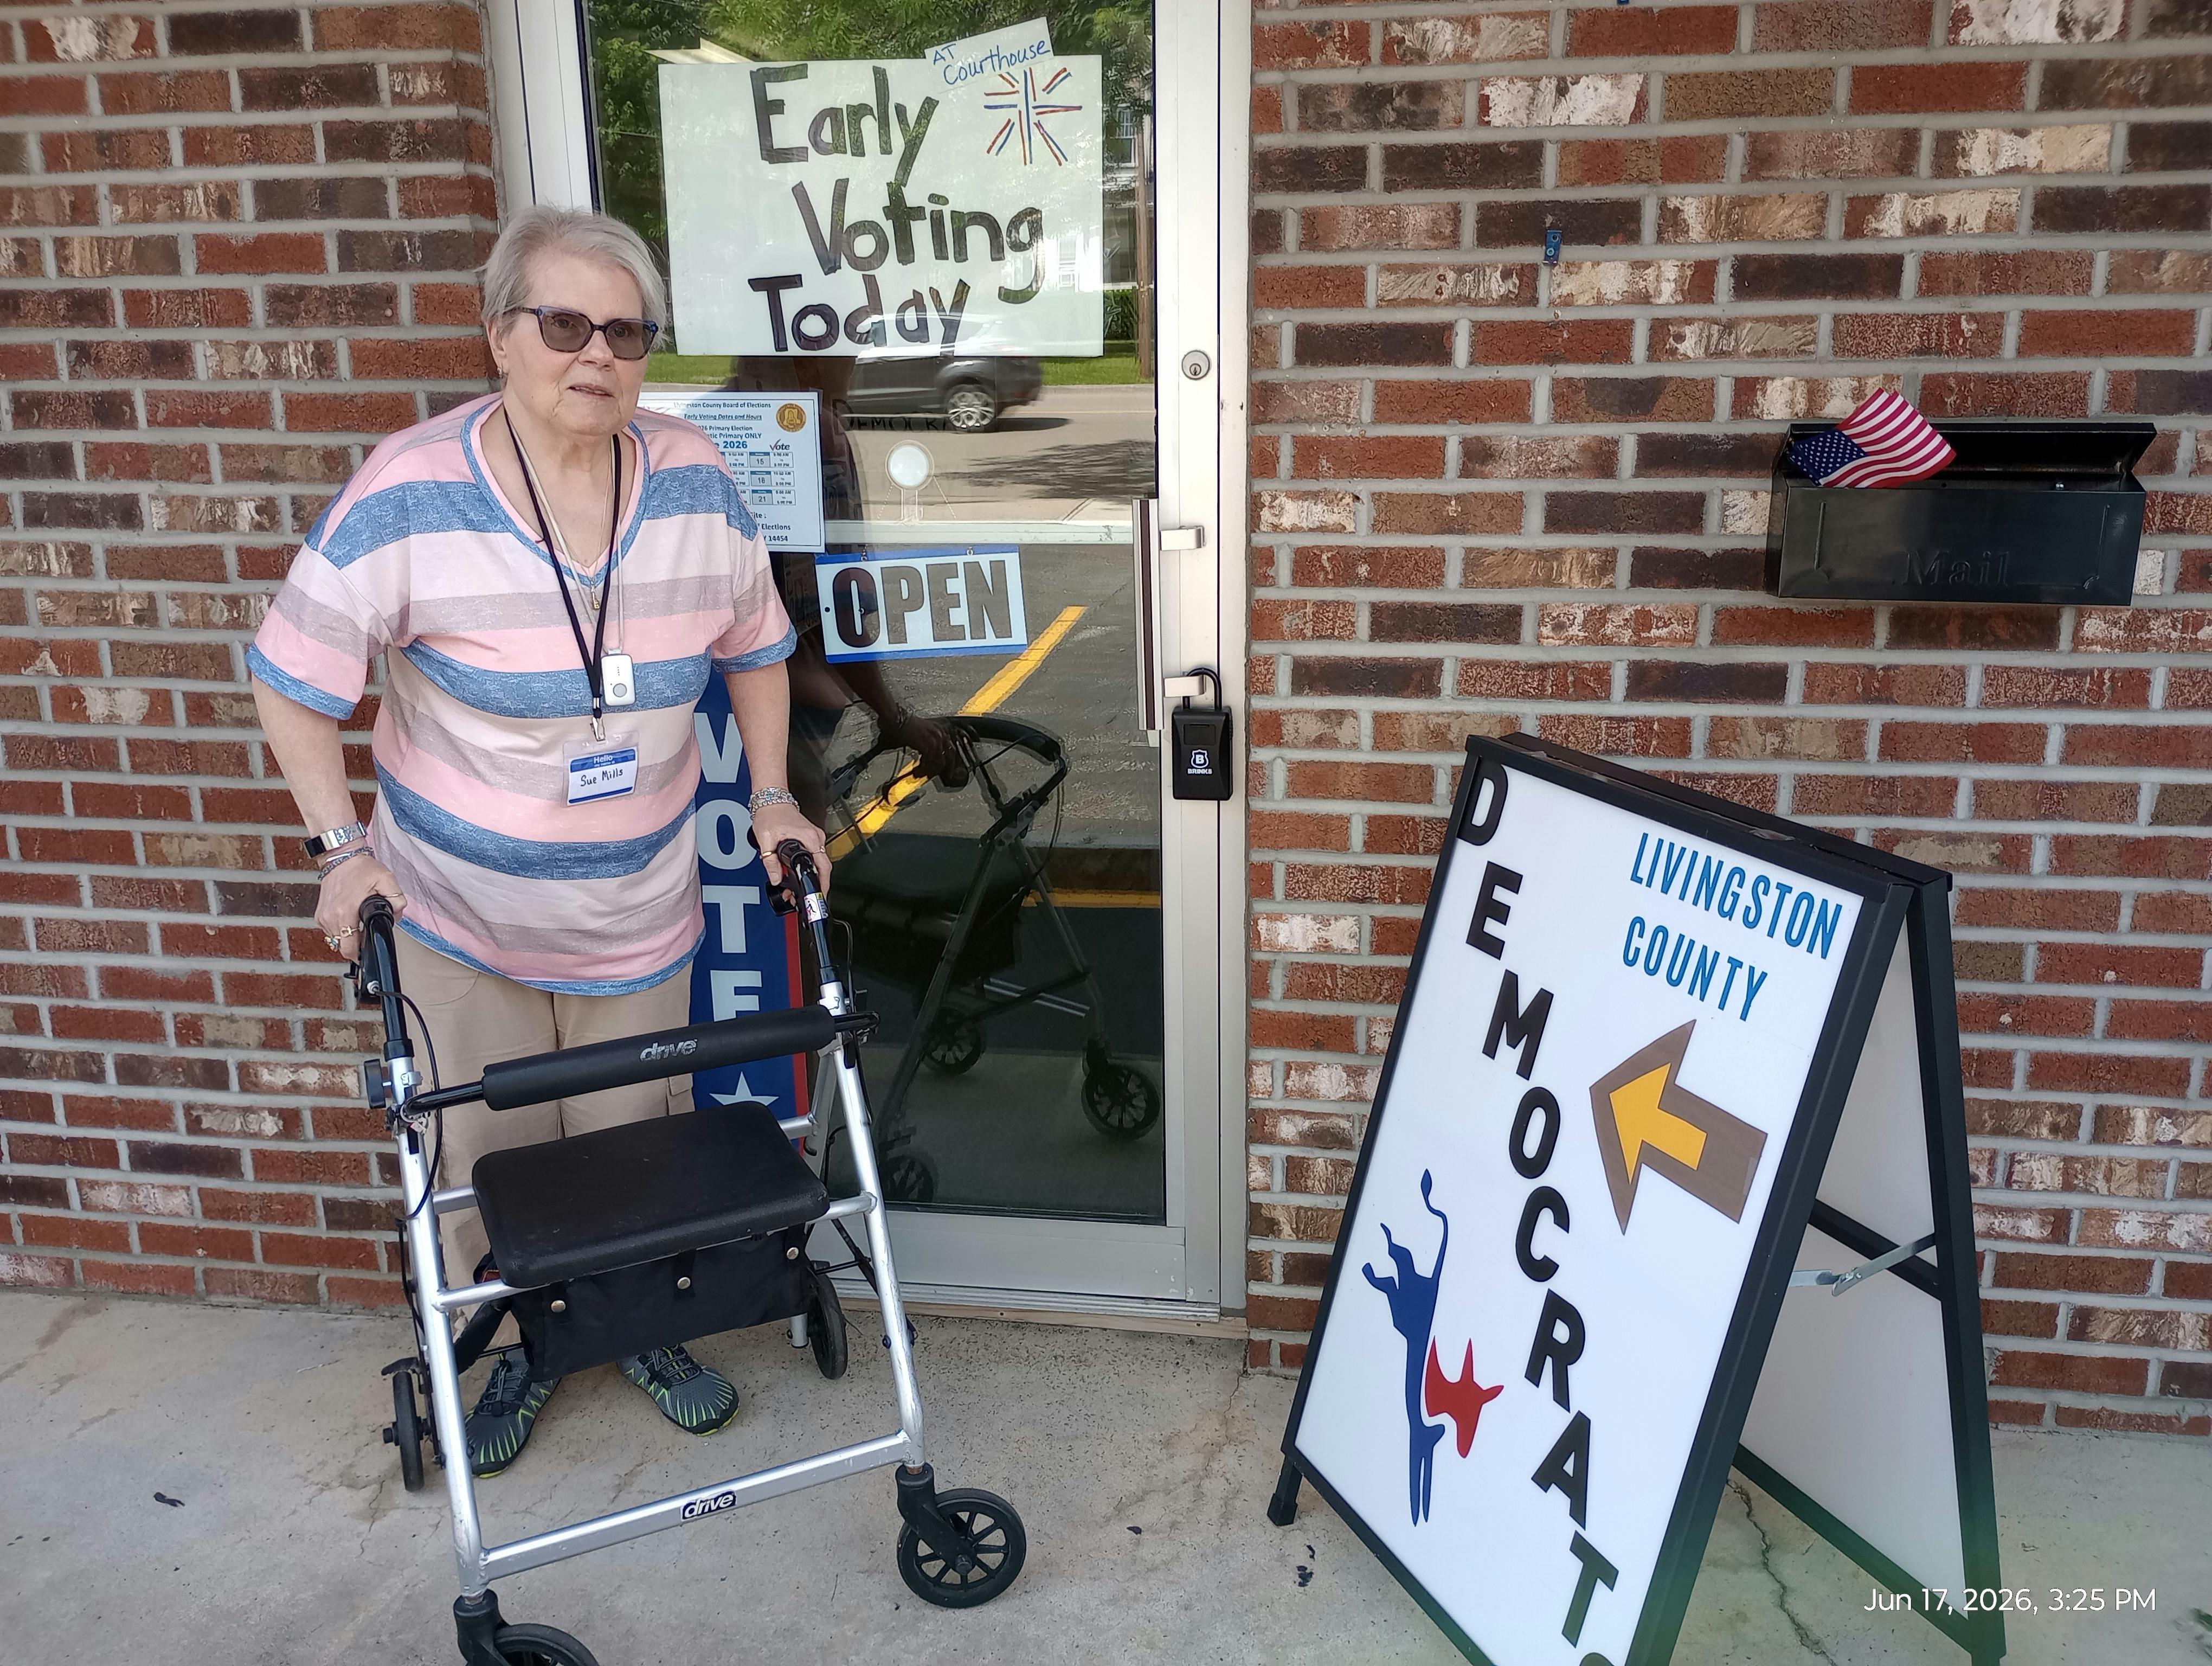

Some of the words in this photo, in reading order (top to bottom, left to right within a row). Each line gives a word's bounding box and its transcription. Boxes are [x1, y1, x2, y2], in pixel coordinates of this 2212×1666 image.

[933, 43, 956, 65] AT
[943, 40, 1051, 85] Courthouse
[750, 64, 939, 186] Early
[792, 178, 1044, 304] Voting
[748, 274, 970, 356] Today
[723, 441, 748, 449] 2026
[1902, 550, 2009, 587] Mail
[832, 560, 1012, 648] OPEN
[580, 775, 597, 786] Sue
[602, 768, 623, 781] Mills
[594, 754, 613, 764] Hello
[1195, 754, 1205, 764] B
[1630, 832, 1843, 960] LIVINGSTON
[1623, 915, 1767, 1022] COUNTY
[640, 1039, 697, 1062] drive
[684, 1493, 734, 1518] drive
